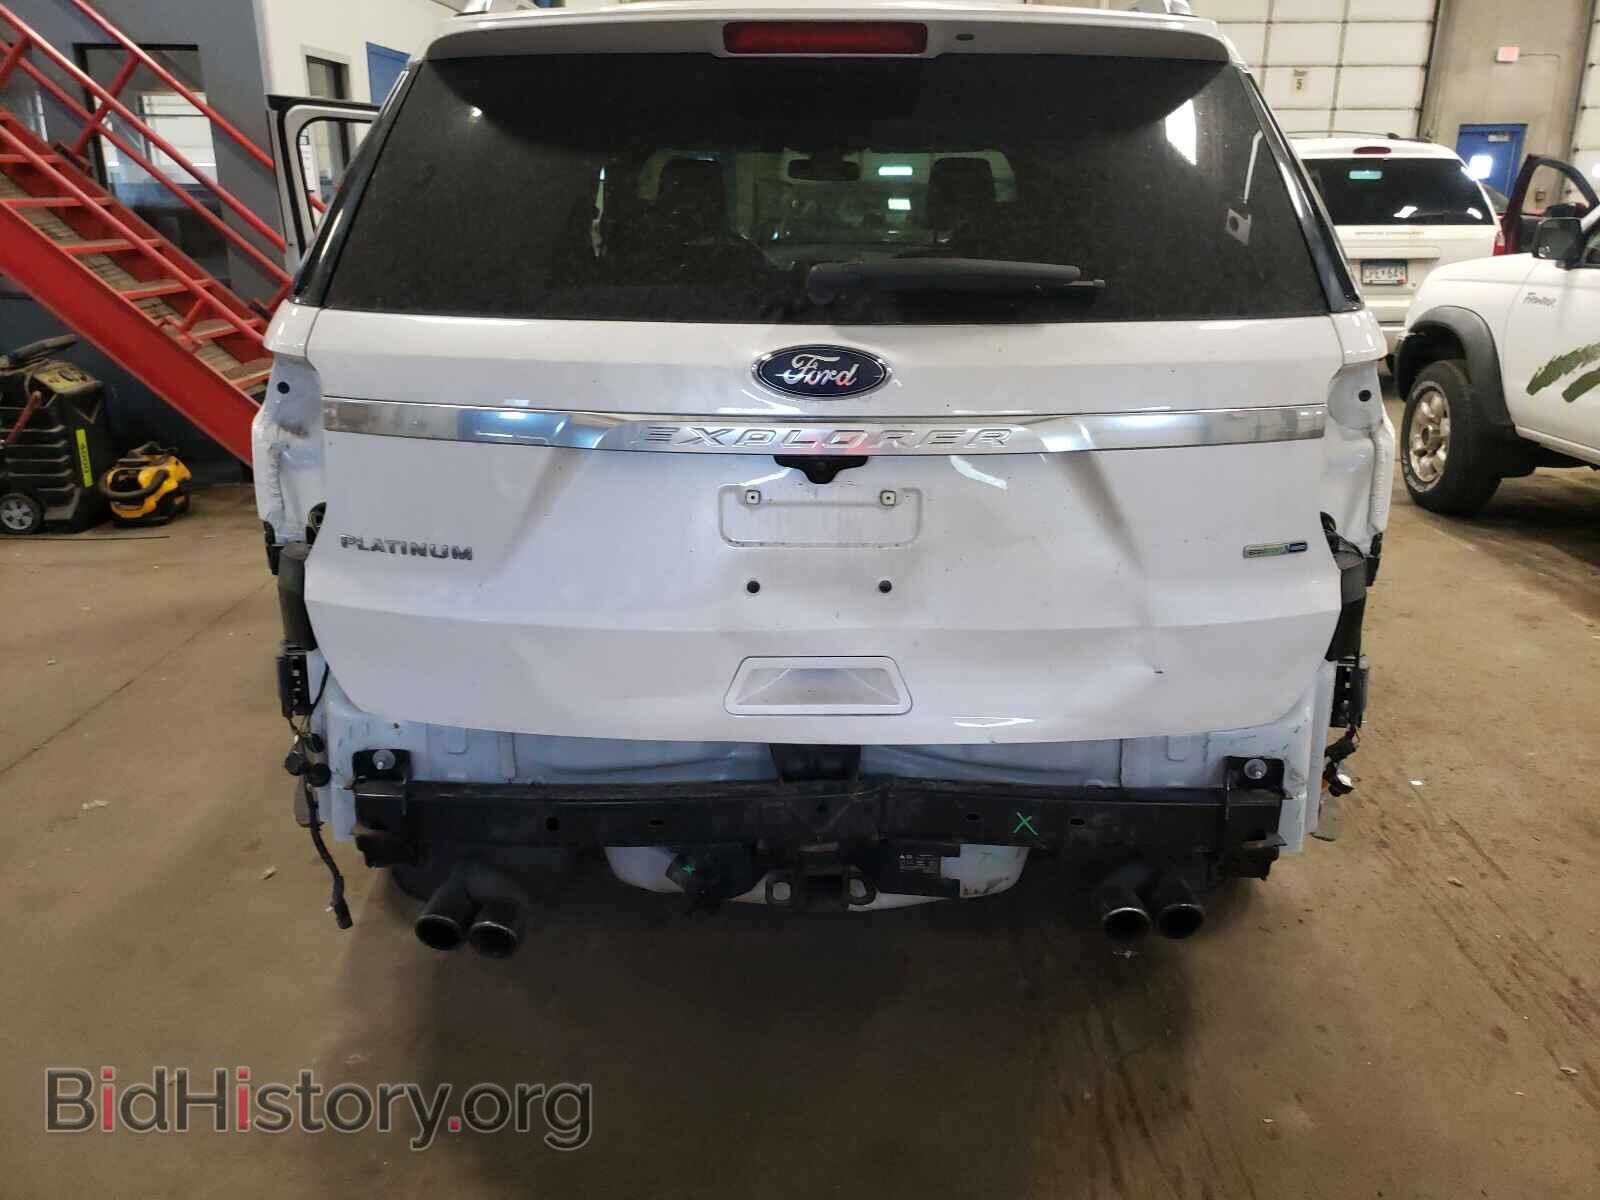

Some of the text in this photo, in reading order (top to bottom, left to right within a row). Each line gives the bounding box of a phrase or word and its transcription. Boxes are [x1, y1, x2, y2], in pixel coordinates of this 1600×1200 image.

[776, 353, 860, 387] Ford
[638, 426, 1013, 449] EXPLORER
[340, 534, 473, 561] PLATINUM
